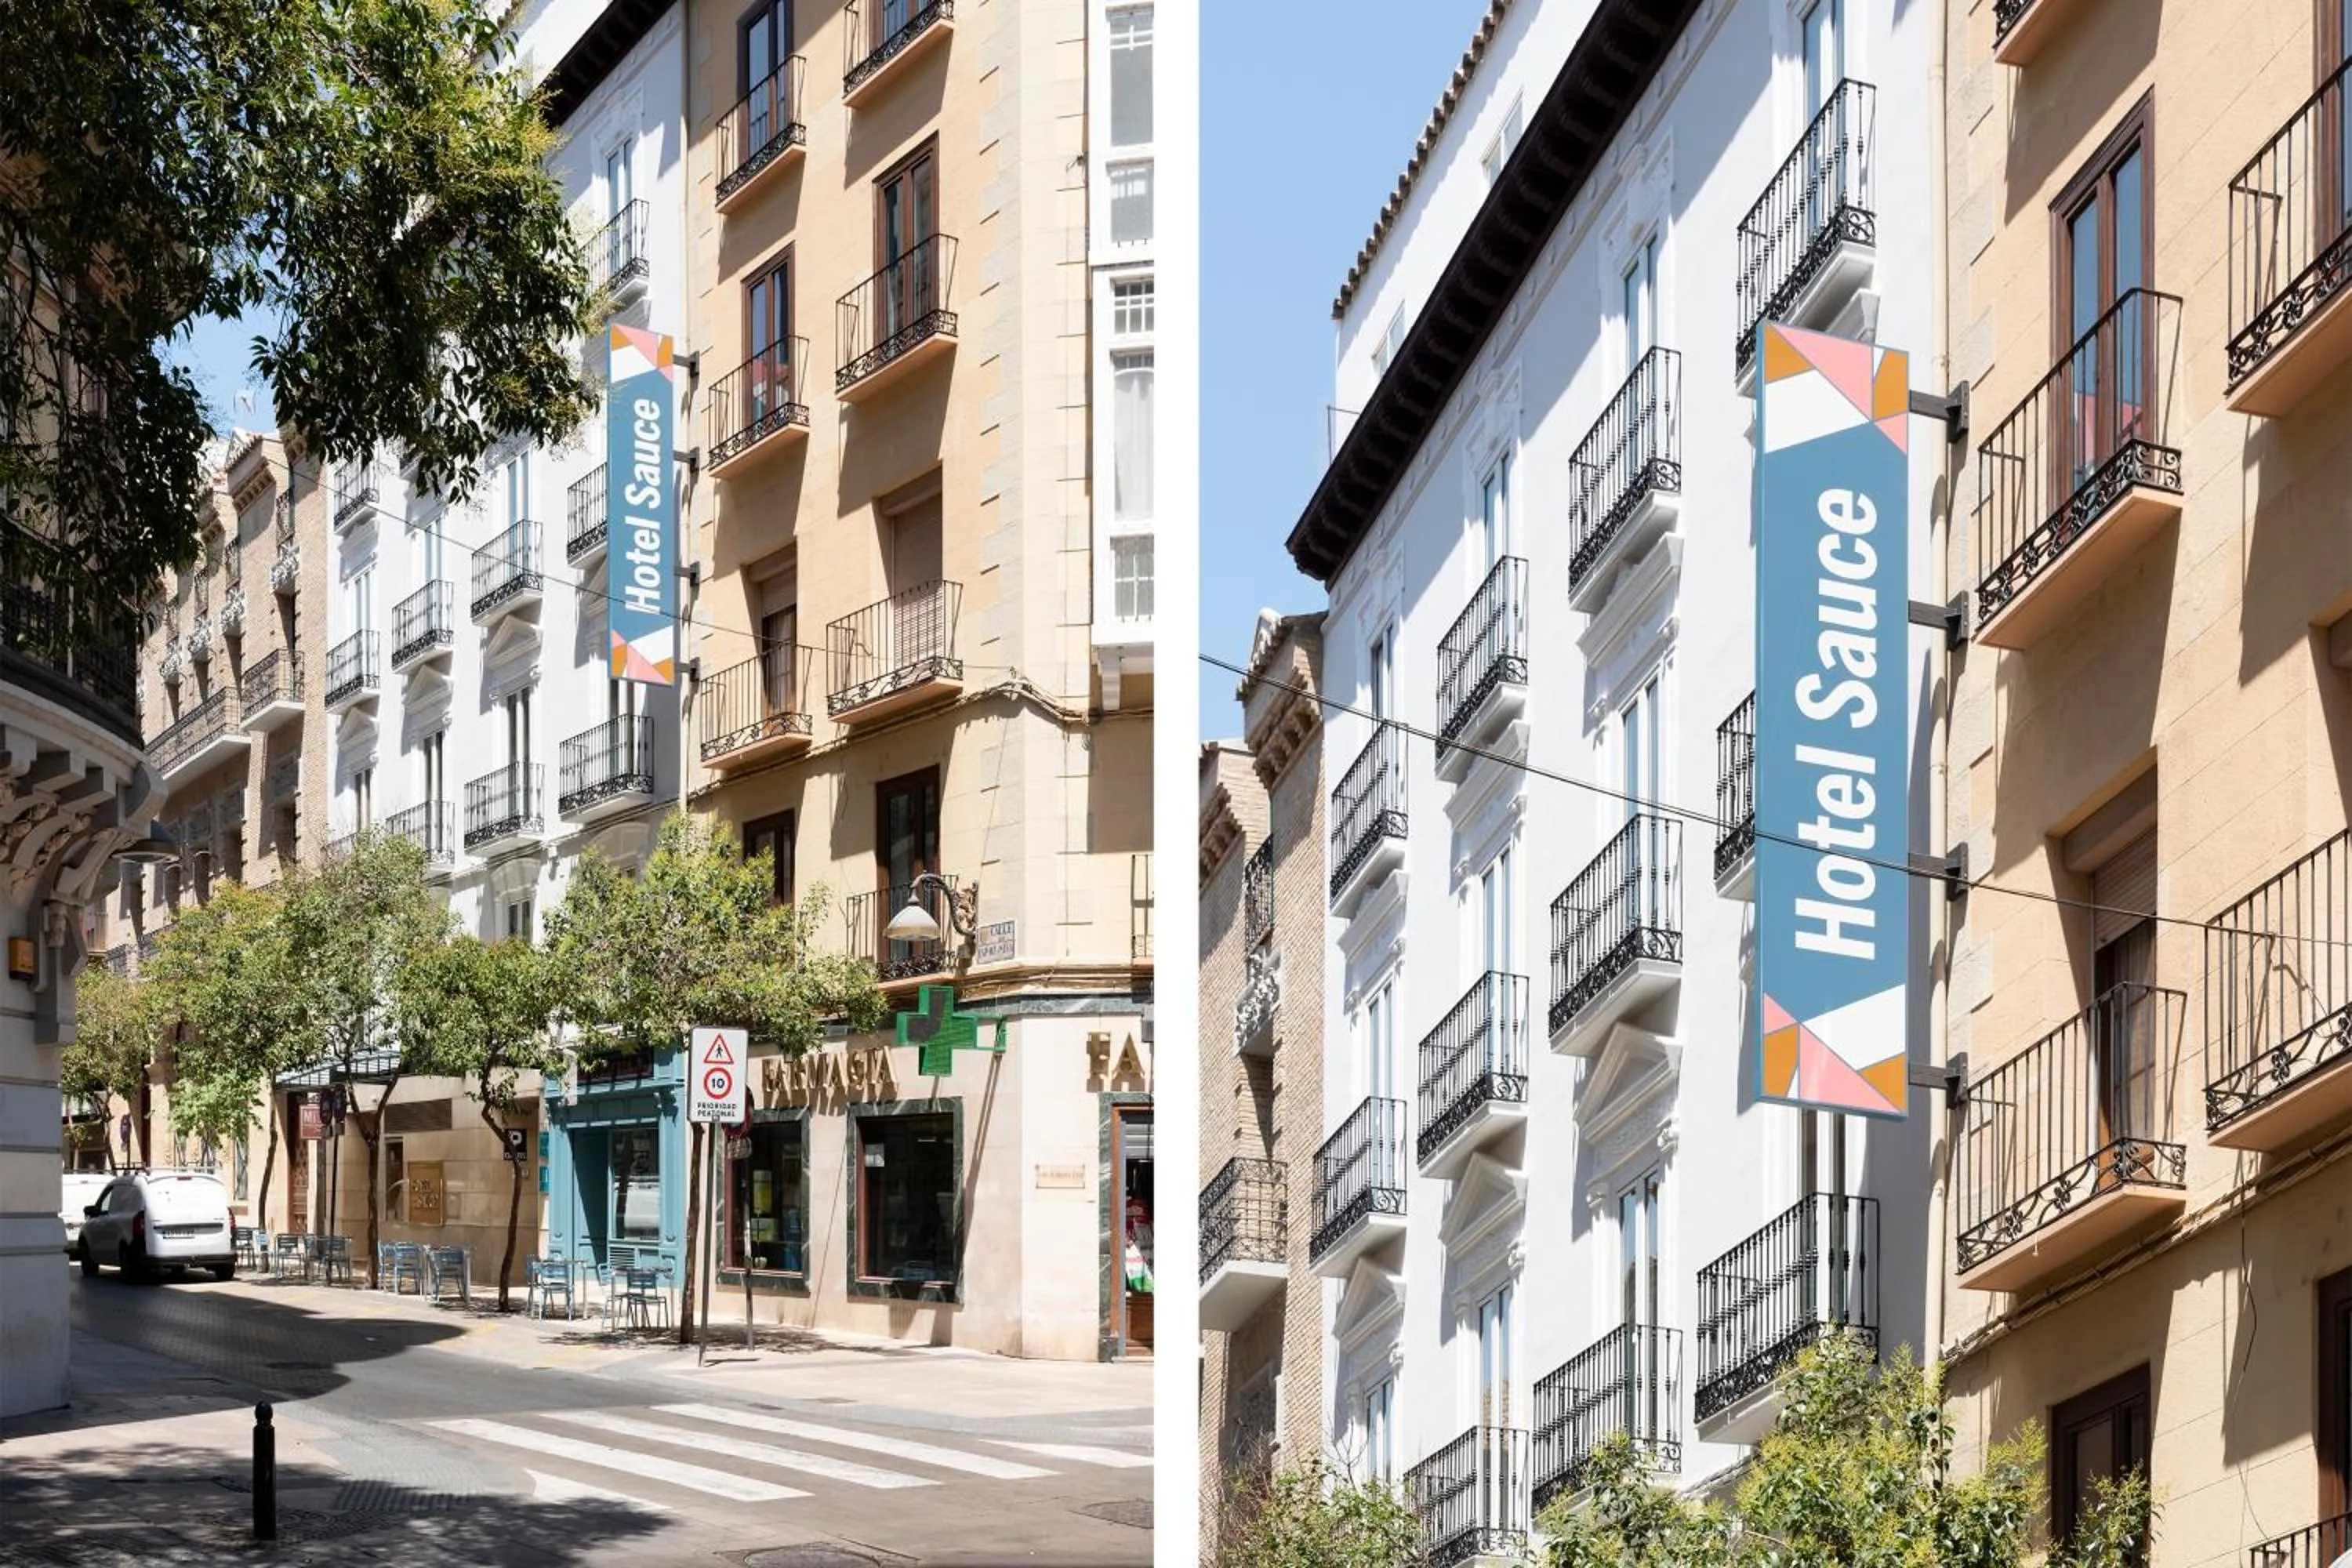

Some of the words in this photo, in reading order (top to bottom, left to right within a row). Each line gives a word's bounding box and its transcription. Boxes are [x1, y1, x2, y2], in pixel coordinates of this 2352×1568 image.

[625, 397, 661, 509] Sauce
[625, 515, 661, 615] Hotel
[1794, 488, 1878, 729] Sauce
[1794, 743, 1877, 961] Hotel
[697, 1109, 736, 1118] PEATONAL
[711, 1078, 725, 1089] 10
